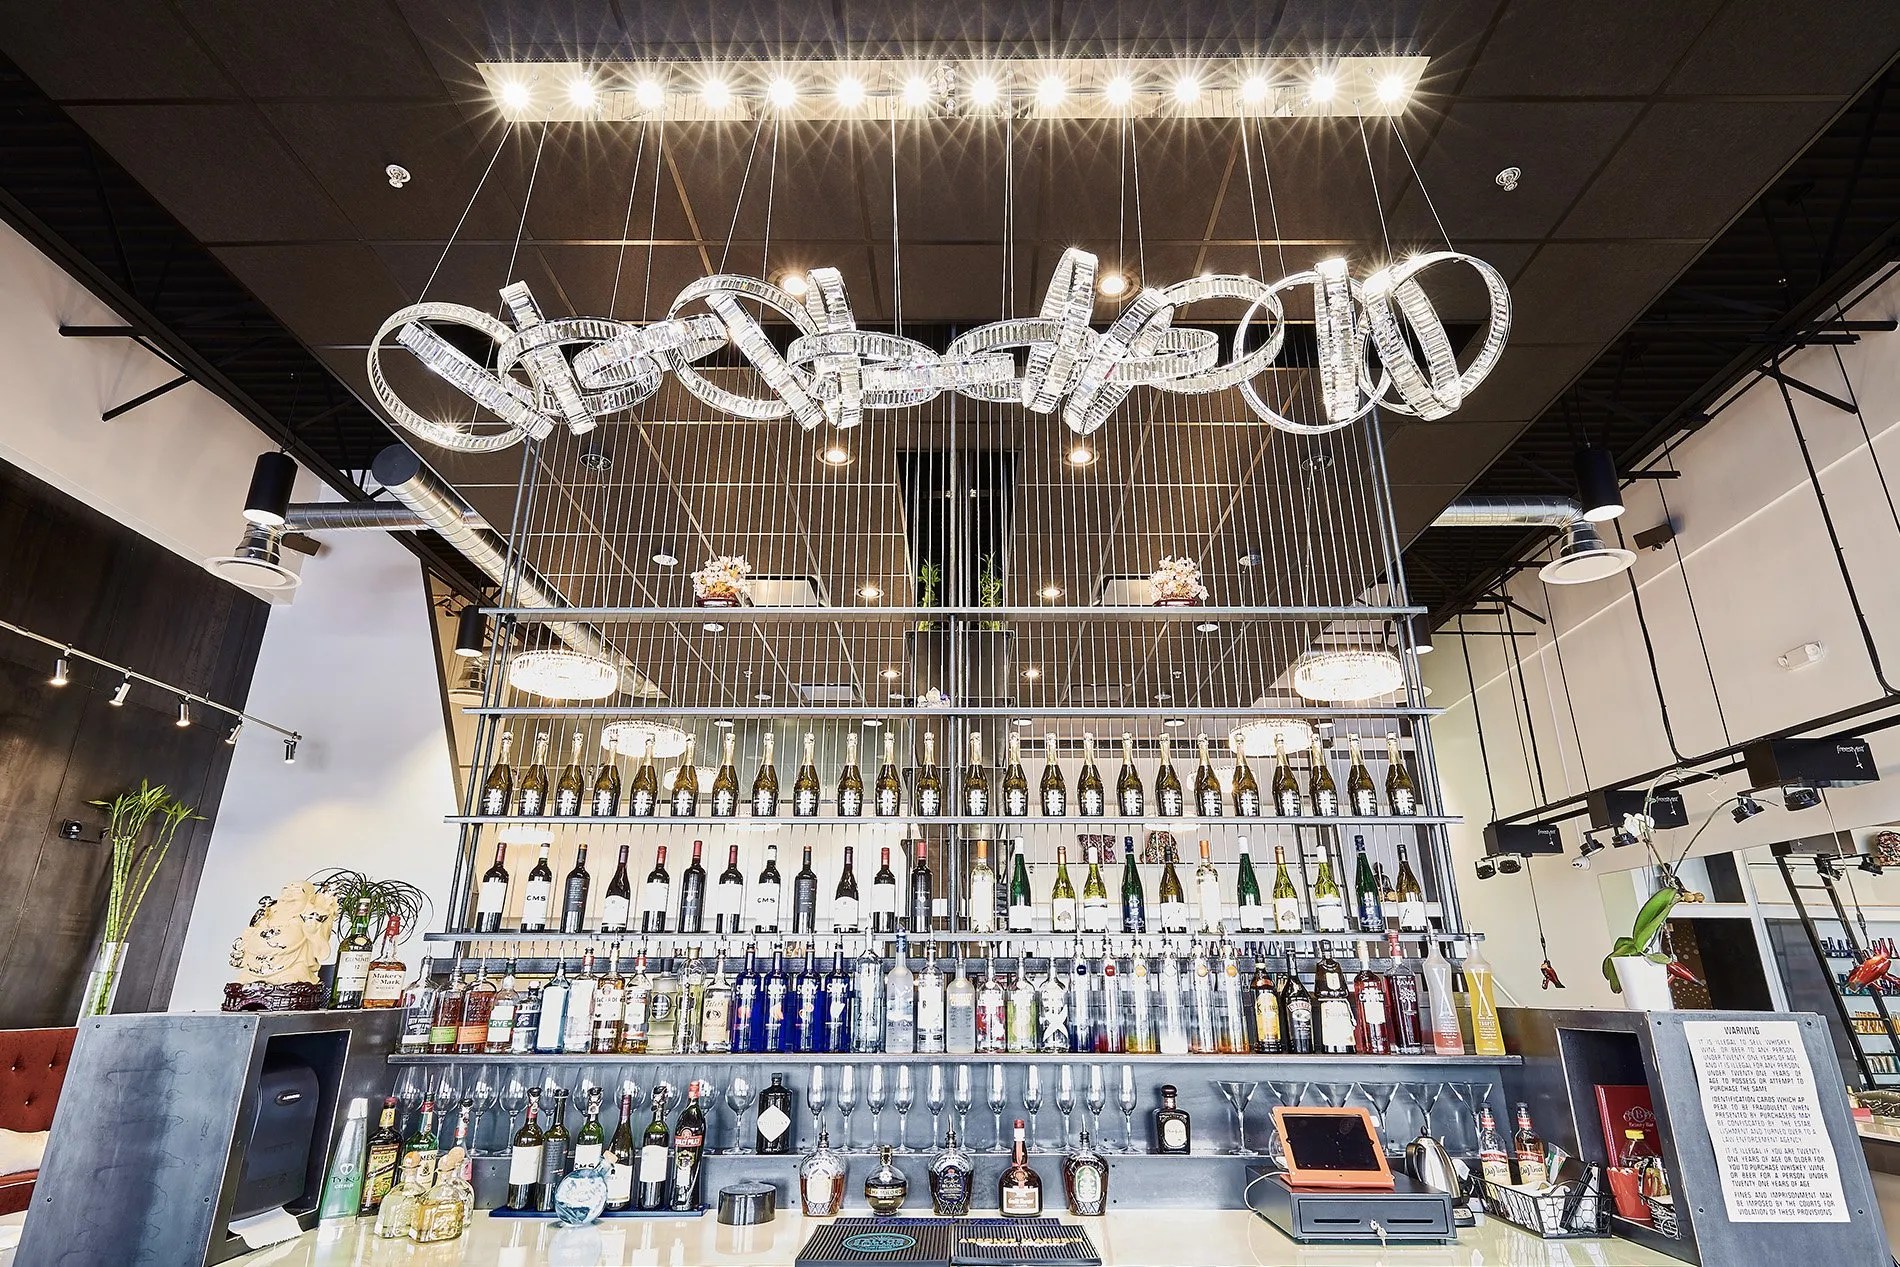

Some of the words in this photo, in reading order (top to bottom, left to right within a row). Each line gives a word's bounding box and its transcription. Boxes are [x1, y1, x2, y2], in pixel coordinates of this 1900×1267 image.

[1432, 968, 1454, 1016] X
[1470, 968, 1493, 1017] X
[1724, 1026, 1760, 1035] WARNING
